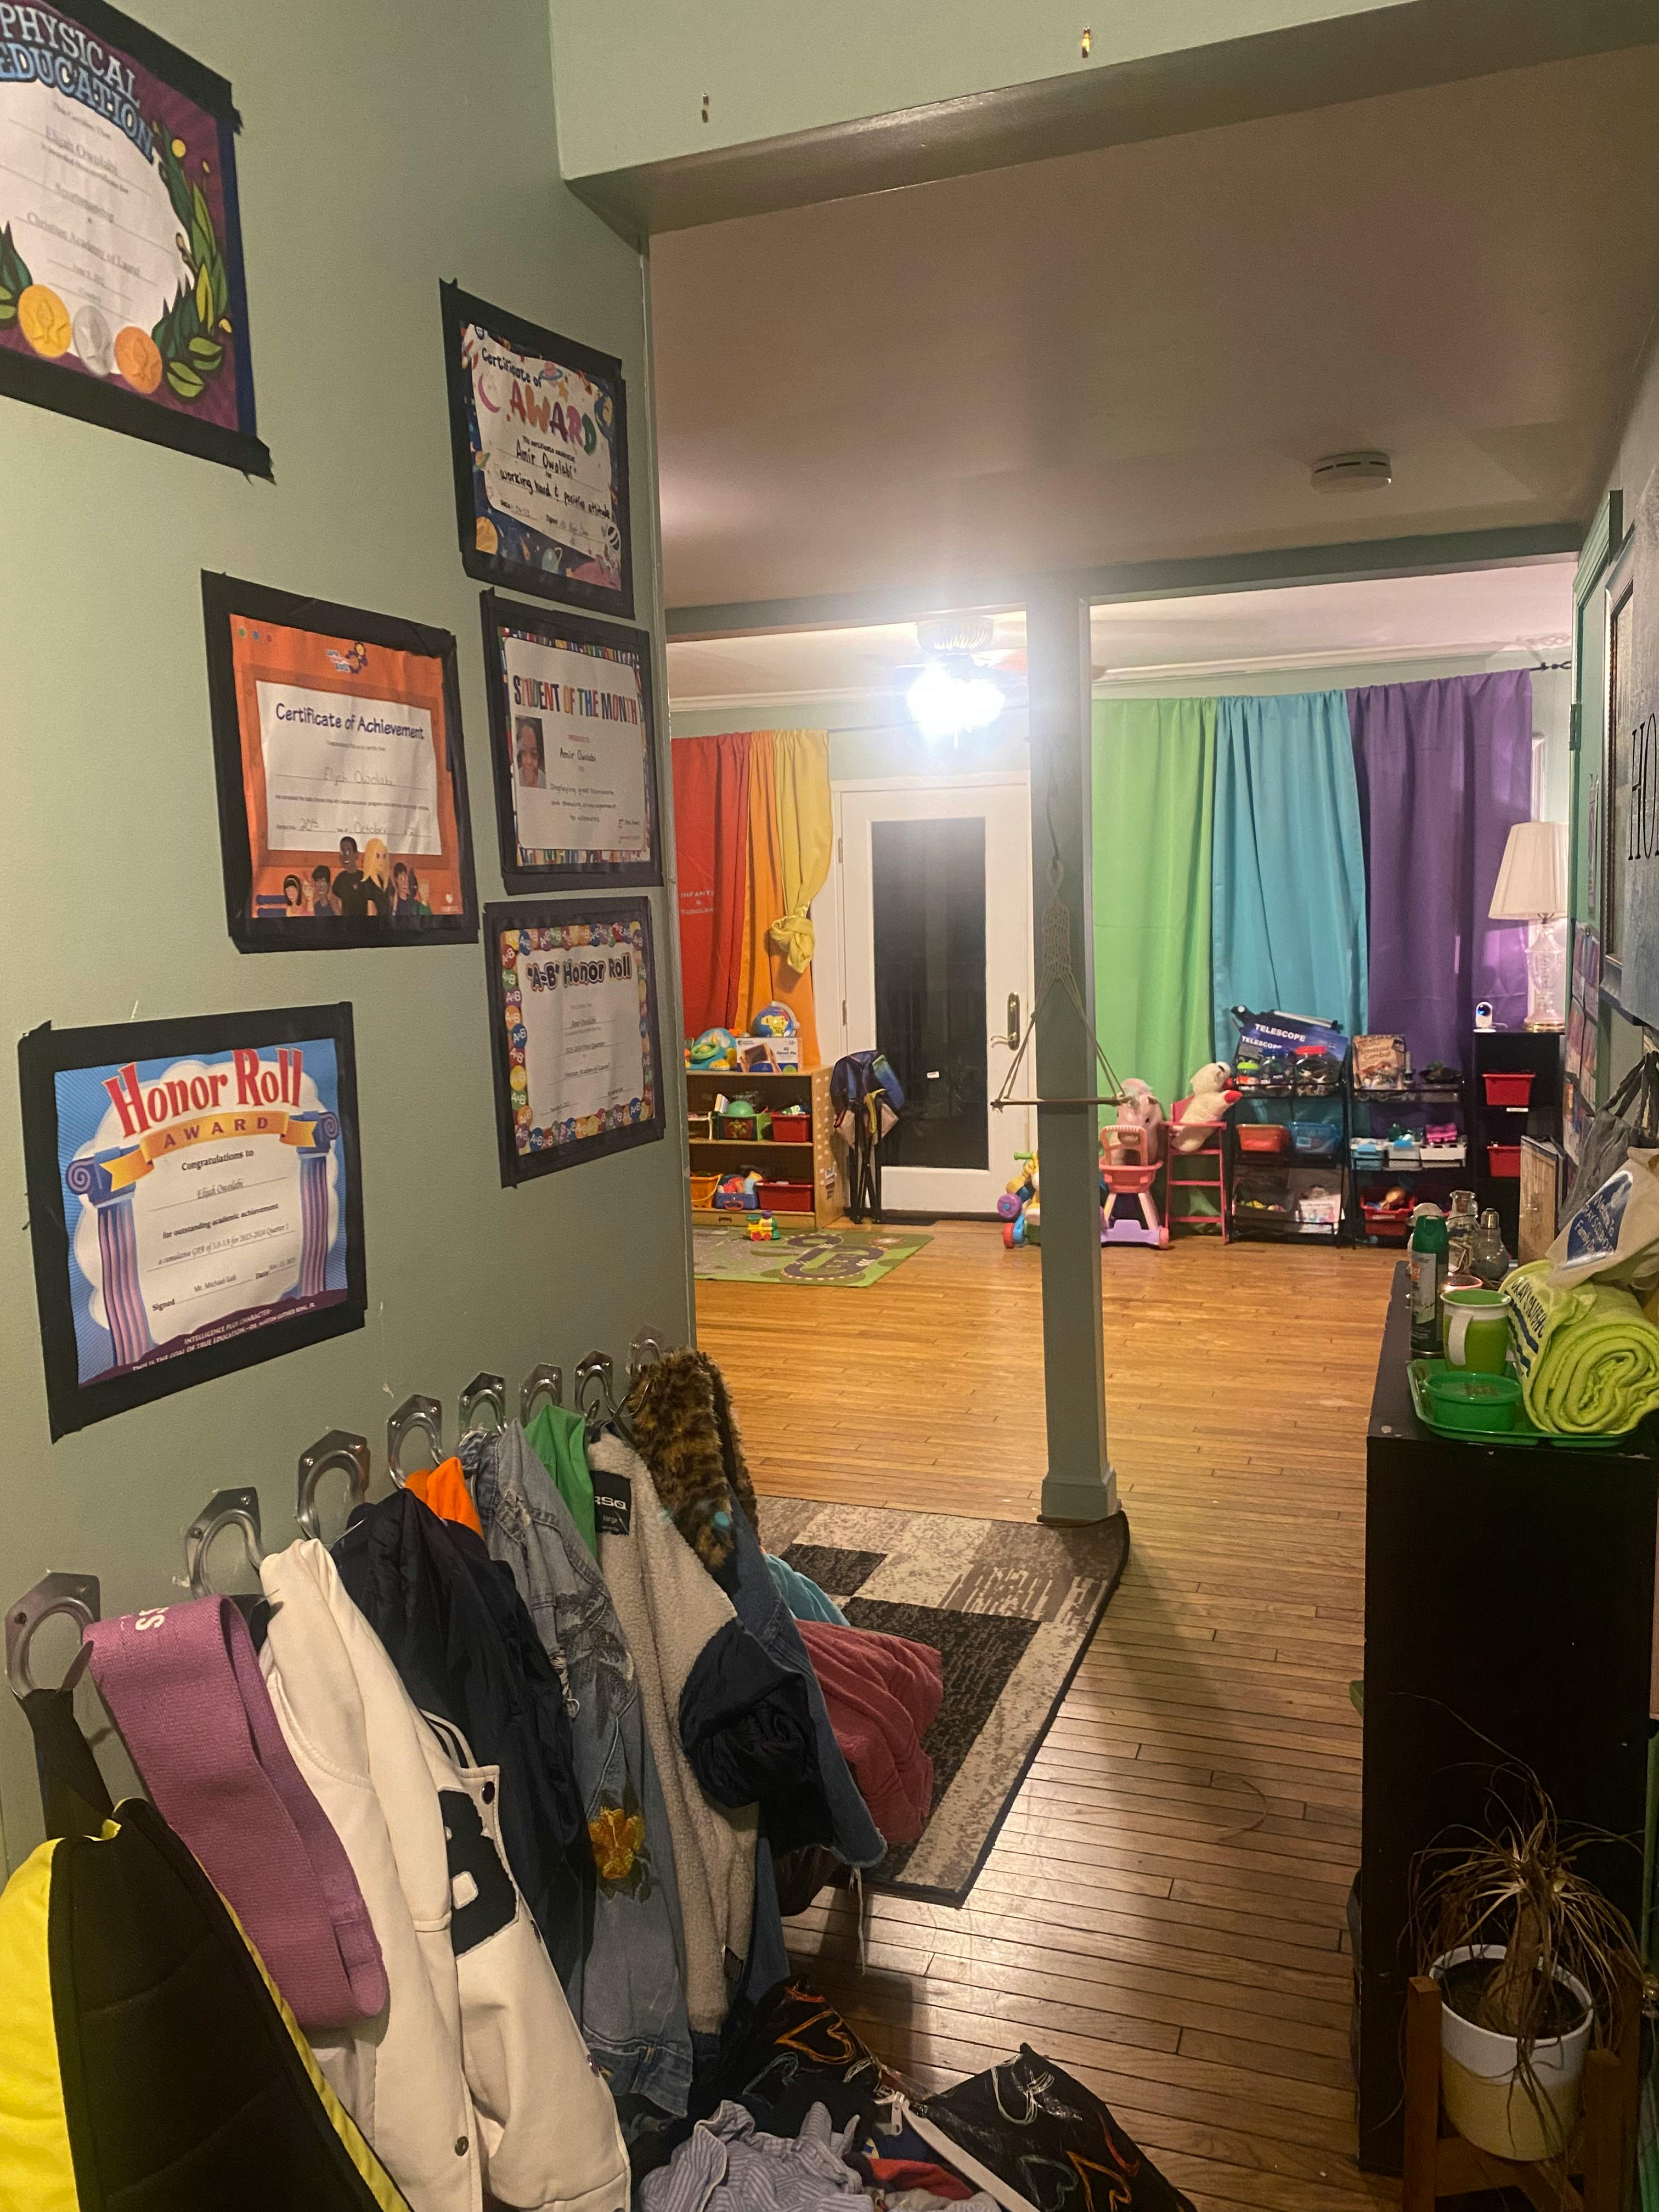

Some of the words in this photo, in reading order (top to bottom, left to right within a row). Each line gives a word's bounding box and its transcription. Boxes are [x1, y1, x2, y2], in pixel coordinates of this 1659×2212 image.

[0, 2, 140, 108] PHYSICAL
[0, 42, 154, 161] EDUCATION
[482, 347, 531, 383] Certificate
[533, 376, 541, 387] of
[510, 380, 597, 456] AWARD
[516, 438, 535, 465] Amir
[542, 452, 573, 479] Owolabi
[500, 469, 533, 495] working
[534, 478, 551, 497] hard
[588, 501, 611, 519] attitude
[513, 675, 560, 712] STUDENT
[563, 685, 575, 715] OF
[577, 687, 599, 718] THE
[601, 692, 638, 725] MONTH
[275, 702, 341, 729] Certificate
[345, 714, 356, 730] of
[357, 716, 424, 740] Achievement
[560, 747, 575, 760] Amir
[1628, 713, 1659, 860] HO
[563, 957, 606, 988] Honor
[608, 952, 632, 980] Roll
[1255, 1023, 1306, 1042] TELESCOPE
[1361, 1046, 1390, 1055] Dinosaur
[101, 1062, 228, 1139] Honor
[232, 1048, 303, 1107] Roll
[164, 1116, 268, 1149] AWARD
[182, 1152, 243, 1171] Congratulations
[197, 1186, 216, 1200] Elijah
[162, 1231, 172, 1239] for
[173, 1221, 211, 1236] outstanding
[212, 1213, 240, 1226] academic
[240, 1203, 279, 1218] achievement
[204, 1277, 226, 1289] Michael
[255, 1271, 269, 1280] Date
[153, 1298, 176, 1312] Signed
[170, 1349, 185, 1359] GOAL
[196, 1339, 212, 1349] TRUE
[213, 1327, 246, 1345] EDUCATION
[276, 1308, 295, 1320] LUTHER
[184, 1325, 225, 1345] INTELLIGENCE
[225, 1319, 239, 1331] PLUS
[603, 1514, 618, 1524] large
